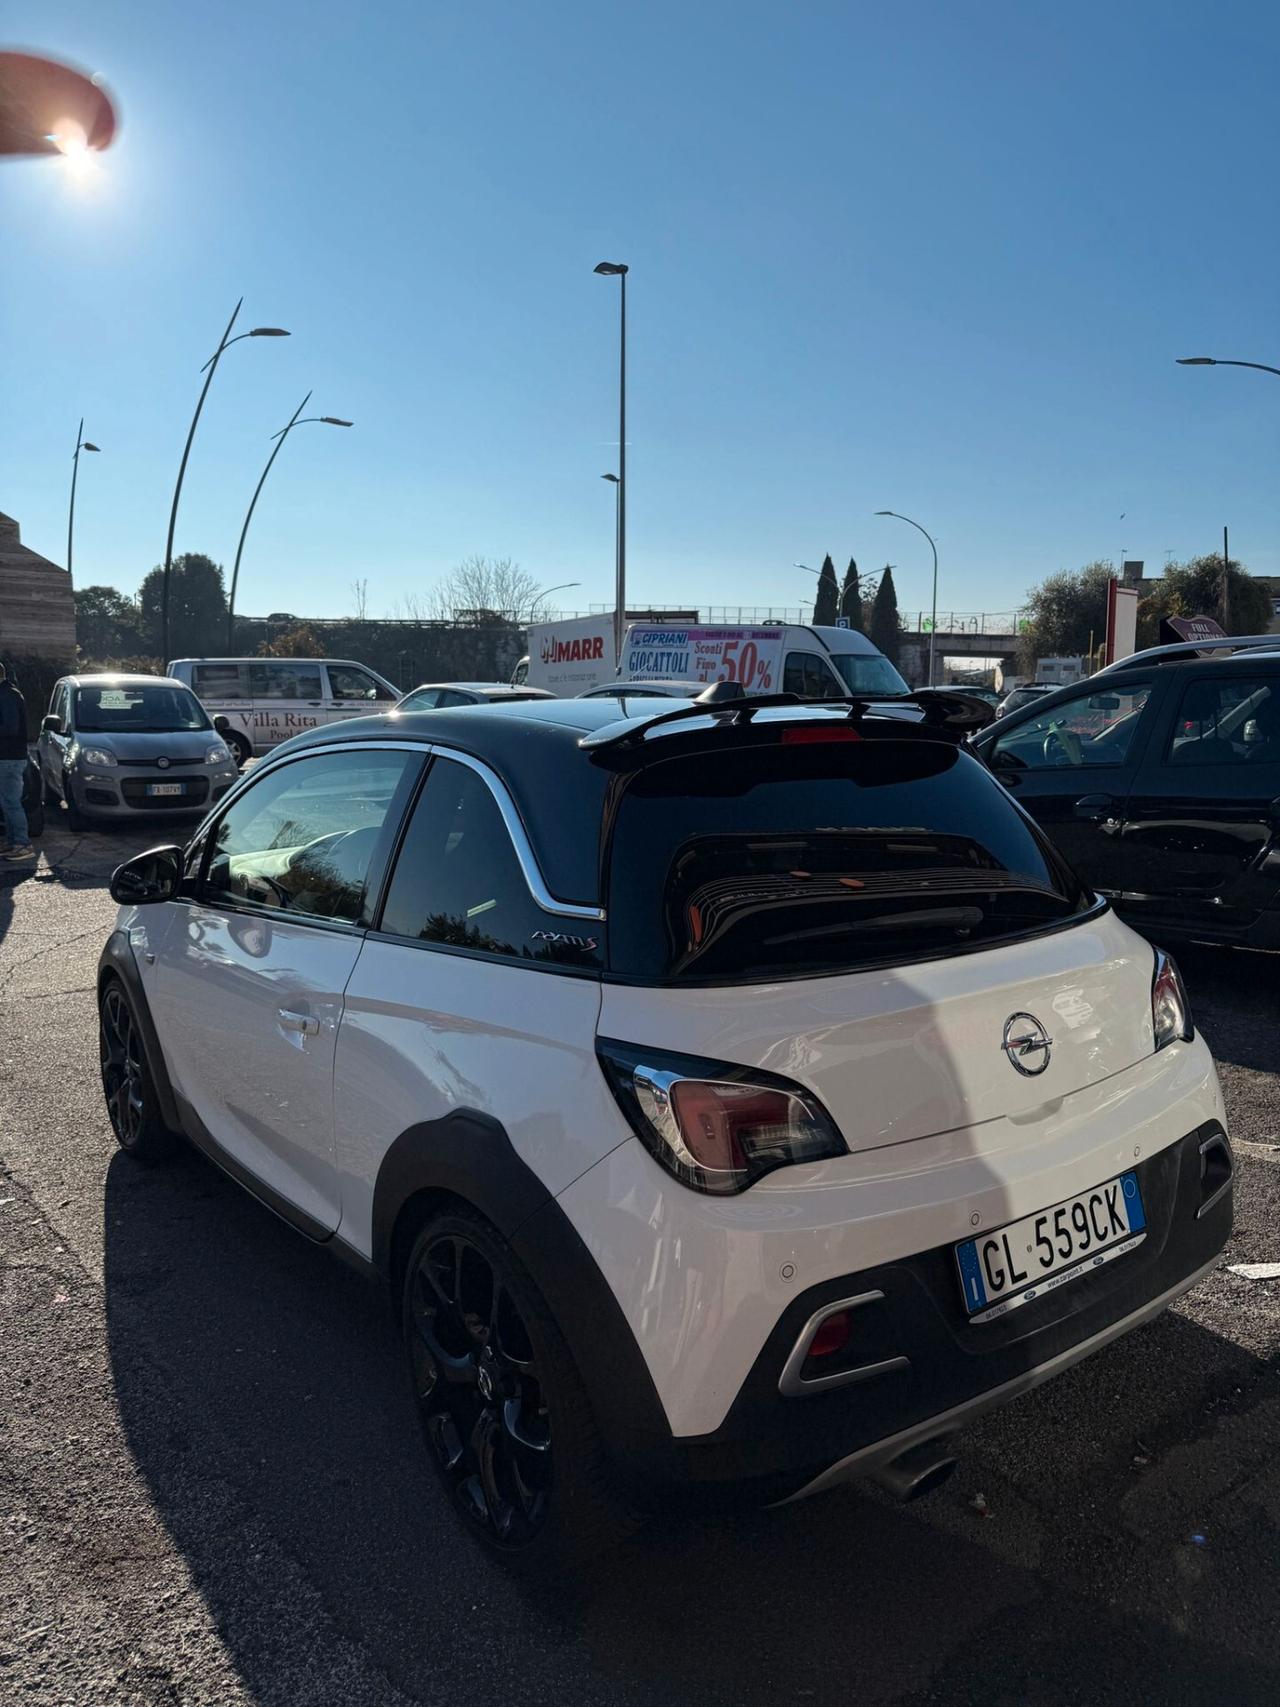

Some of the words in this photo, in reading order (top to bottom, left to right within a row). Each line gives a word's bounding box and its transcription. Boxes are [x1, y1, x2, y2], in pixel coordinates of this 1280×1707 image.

[1191, 623, 1210, 633] FULL
[642, 633, 688, 644] CIPRIANI
[557, 636, 604, 663] MARR
[695, 641, 722, 655] Sconti
[629, 651, 690, 673] GIOCATTOLI
[696, 657, 716, 670] Fino
[718, 641, 772, 689] 50%
[240, 712, 279, 727] Villa
[284, 712, 317, 727] Rita
[270, 729, 294, 739] Pool
[982, 1233, 1028, 1292] GL
[1034, 1184, 1127, 1270] 559CK
[1047, 1265, 1085, 1289] www.carpoint.it
